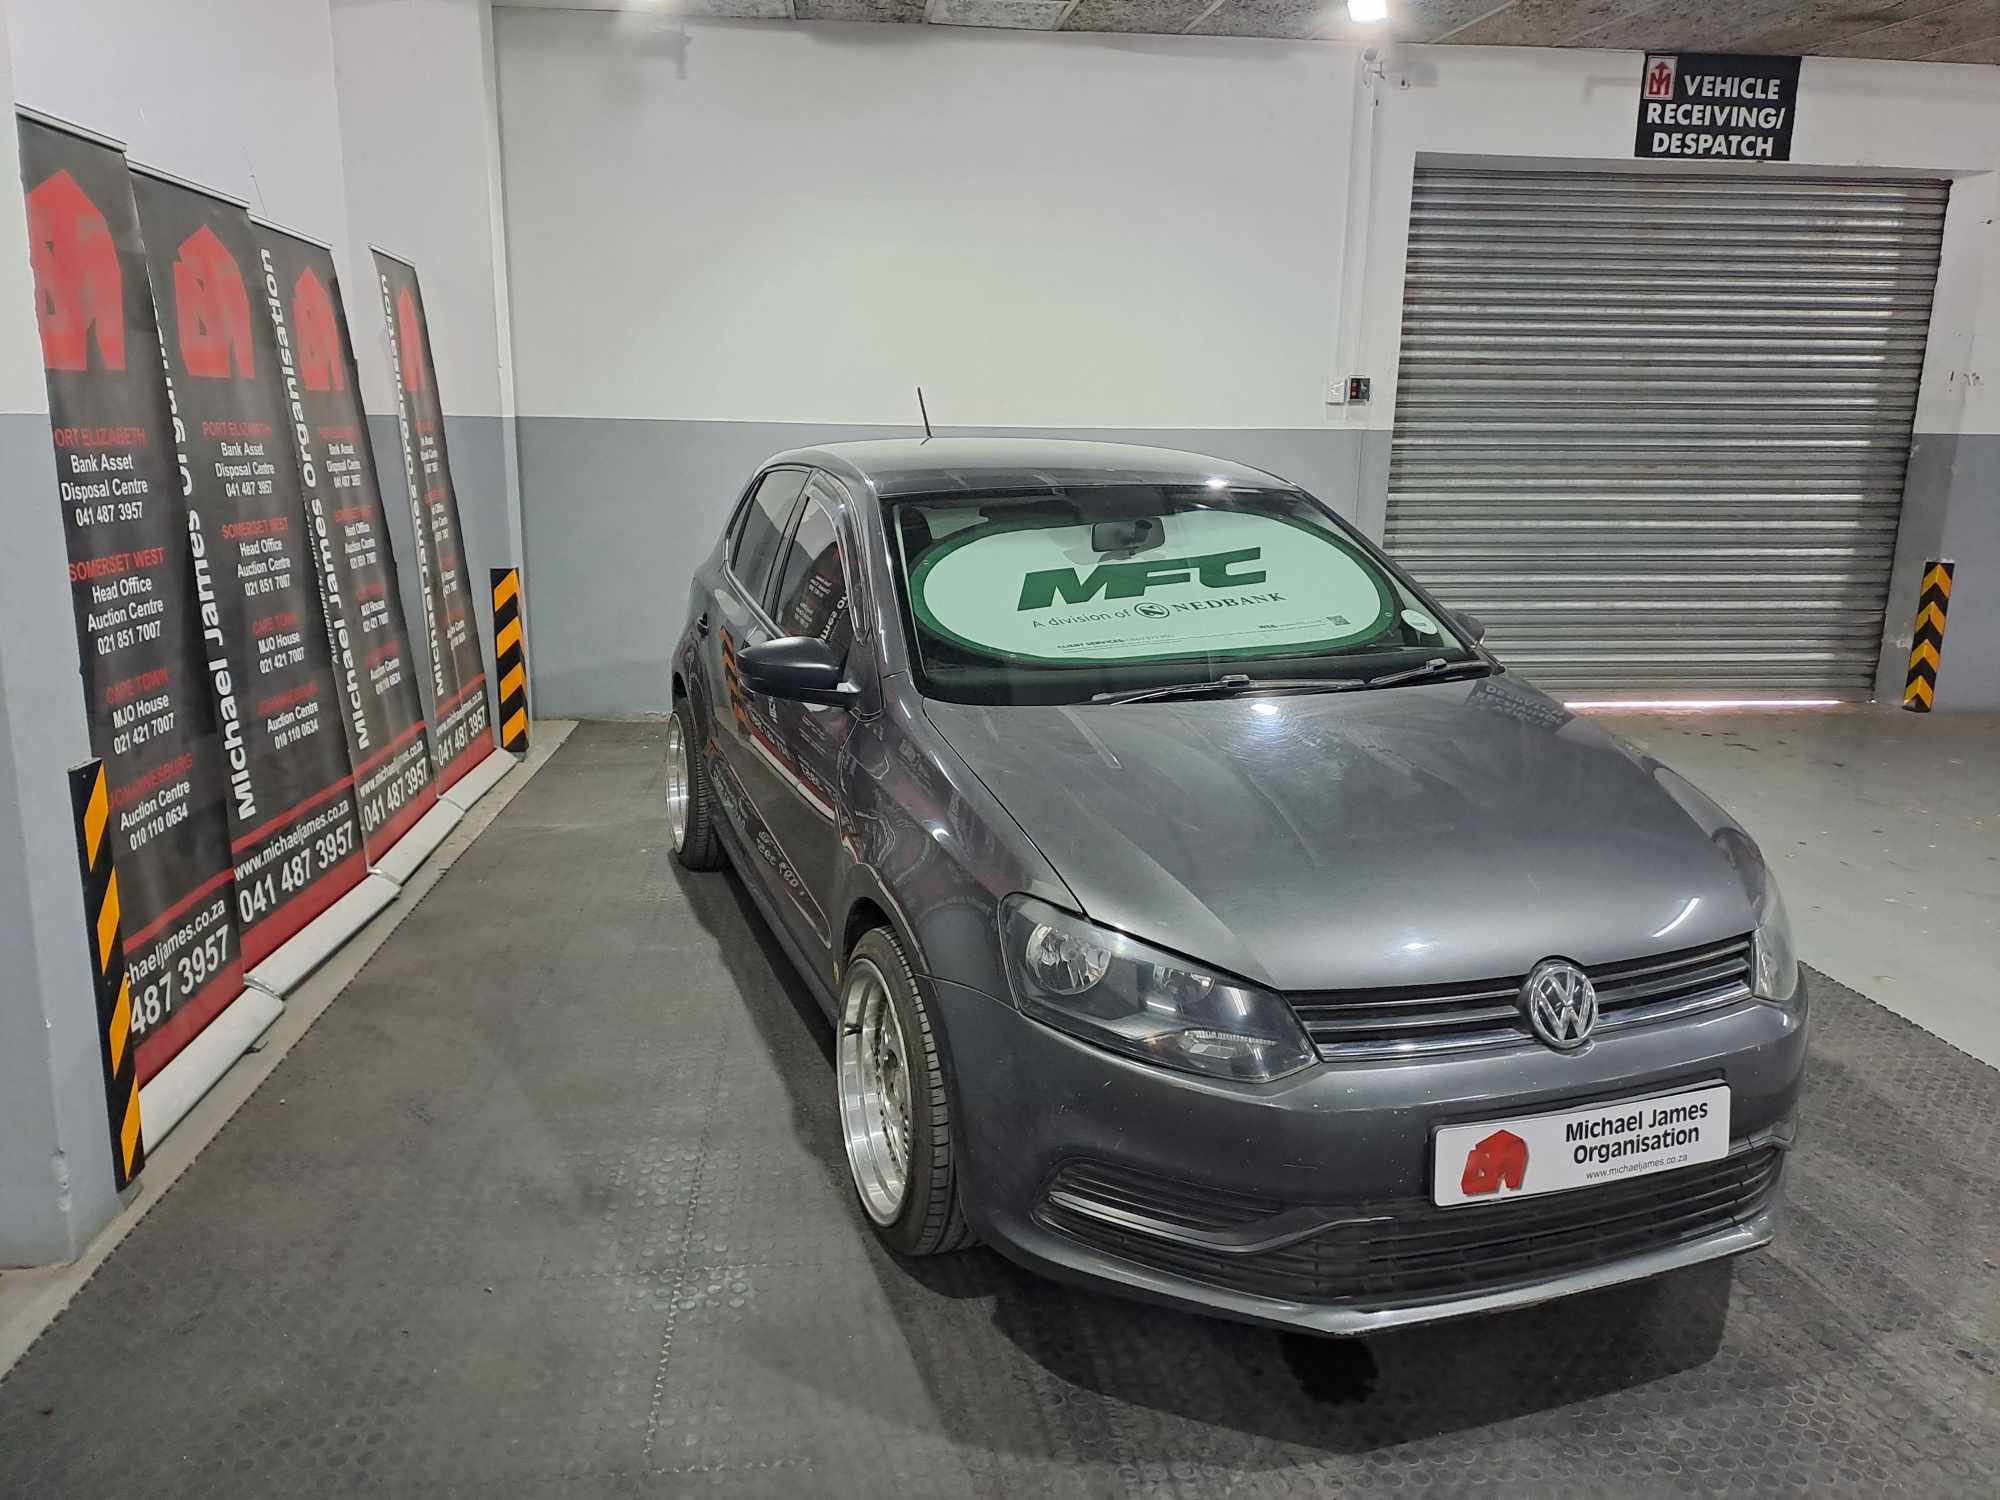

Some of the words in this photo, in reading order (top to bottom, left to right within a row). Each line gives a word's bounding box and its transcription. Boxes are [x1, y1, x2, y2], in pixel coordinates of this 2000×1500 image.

[1684, 75, 1781, 100] VEHICLE
[1646, 103, 1785, 129] RECEIVING/
[1652, 132, 1774, 157] DESPATCH
[260, 248, 318, 488] Organisation
[55, 428, 80, 448] ORT
[220, 441, 243, 457] Bank
[244, 442, 264, 456] Asset
[70, 453, 99, 474] Bank
[100, 453, 134, 472] Asset
[214, 462, 252, 480] Disposal
[61, 479, 110, 503] Disposal
[112, 477, 149, 496] Centre
[225, 482, 240, 497] 041
[241, 481, 256, 496] 487
[75, 506, 95, 527] 041
[96, 503, 115, 523] 487
[118, 501, 143, 521] 3957
[239, 540, 260, 557] Head
[260, 537, 283, 553] Office
[310, 498, 342, 609] James
[188, 510, 224, 647] James
[237, 560, 268, 578] Auction
[1016, 546, 1268, 612] MFC
[92, 580, 119, 604] Head
[119, 576, 153, 597] Office
[244, 582, 259, 597] 021
[259, 577, 274, 593] 851
[87, 607, 128, 632] Auction
[128, 599, 164, 619] Centre
[1032, 620, 1046, 629] A
[1048, 612, 1112, 627] division
[1114, 609, 1132, 619] of
[1171, 592, 1288, 613] NEDBANK
[97, 633, 116, 656] 021
[117, 627, 135, 649] 851
[136, 620, 161, 642] 7007
[275, 632, 300, 648] House
[259, 658, 273, 674] 021
[273, 652, 288, 669] 421
[333, 619, 370, 750] Michael
[112, 701, 135, 729] MJO
[136, 694, 170, 718] House
[267, 712, 295, 733] Auction
[294, 701, 319, 720] Centre
[113, 734, 132, 755] 021
[132, 722, 150, 745] 421
[151, 712, 175, 738] 7007
[208, 658, 257, 820] Michael
[438, 734, 454, 768] 041
[469, 705, 486, 738] 3957
[120, 802, 158, 831] Auction
[158, 780, 191, 808] Centre
[363, 794, 386, 832] 041
[387, 777, 406, 811] 487
[405, 757, 428, 795] 3957
[129, 827, 147, 850] 010
[147, 814, 165, 841] 110
[165, 802, 189, 828] 0634
[233, 799, 350, 882] www.michaeljames.co.za
[239, 872, 277, 924] 041
[281, 848, 312, 893] 487
[316, 820, 352, 870] 3957
[131, 970, 172, 1035] 487
[177, 924, 229, 996] 3957
[1565, 1111, 1643, 1142] Michael
[1648, 1101, 1709, 1128] James
[1573, 1126, 1700, 1165] Organisation
[1586, 1152, 1688, 1180] www.michaeljames.co.za
